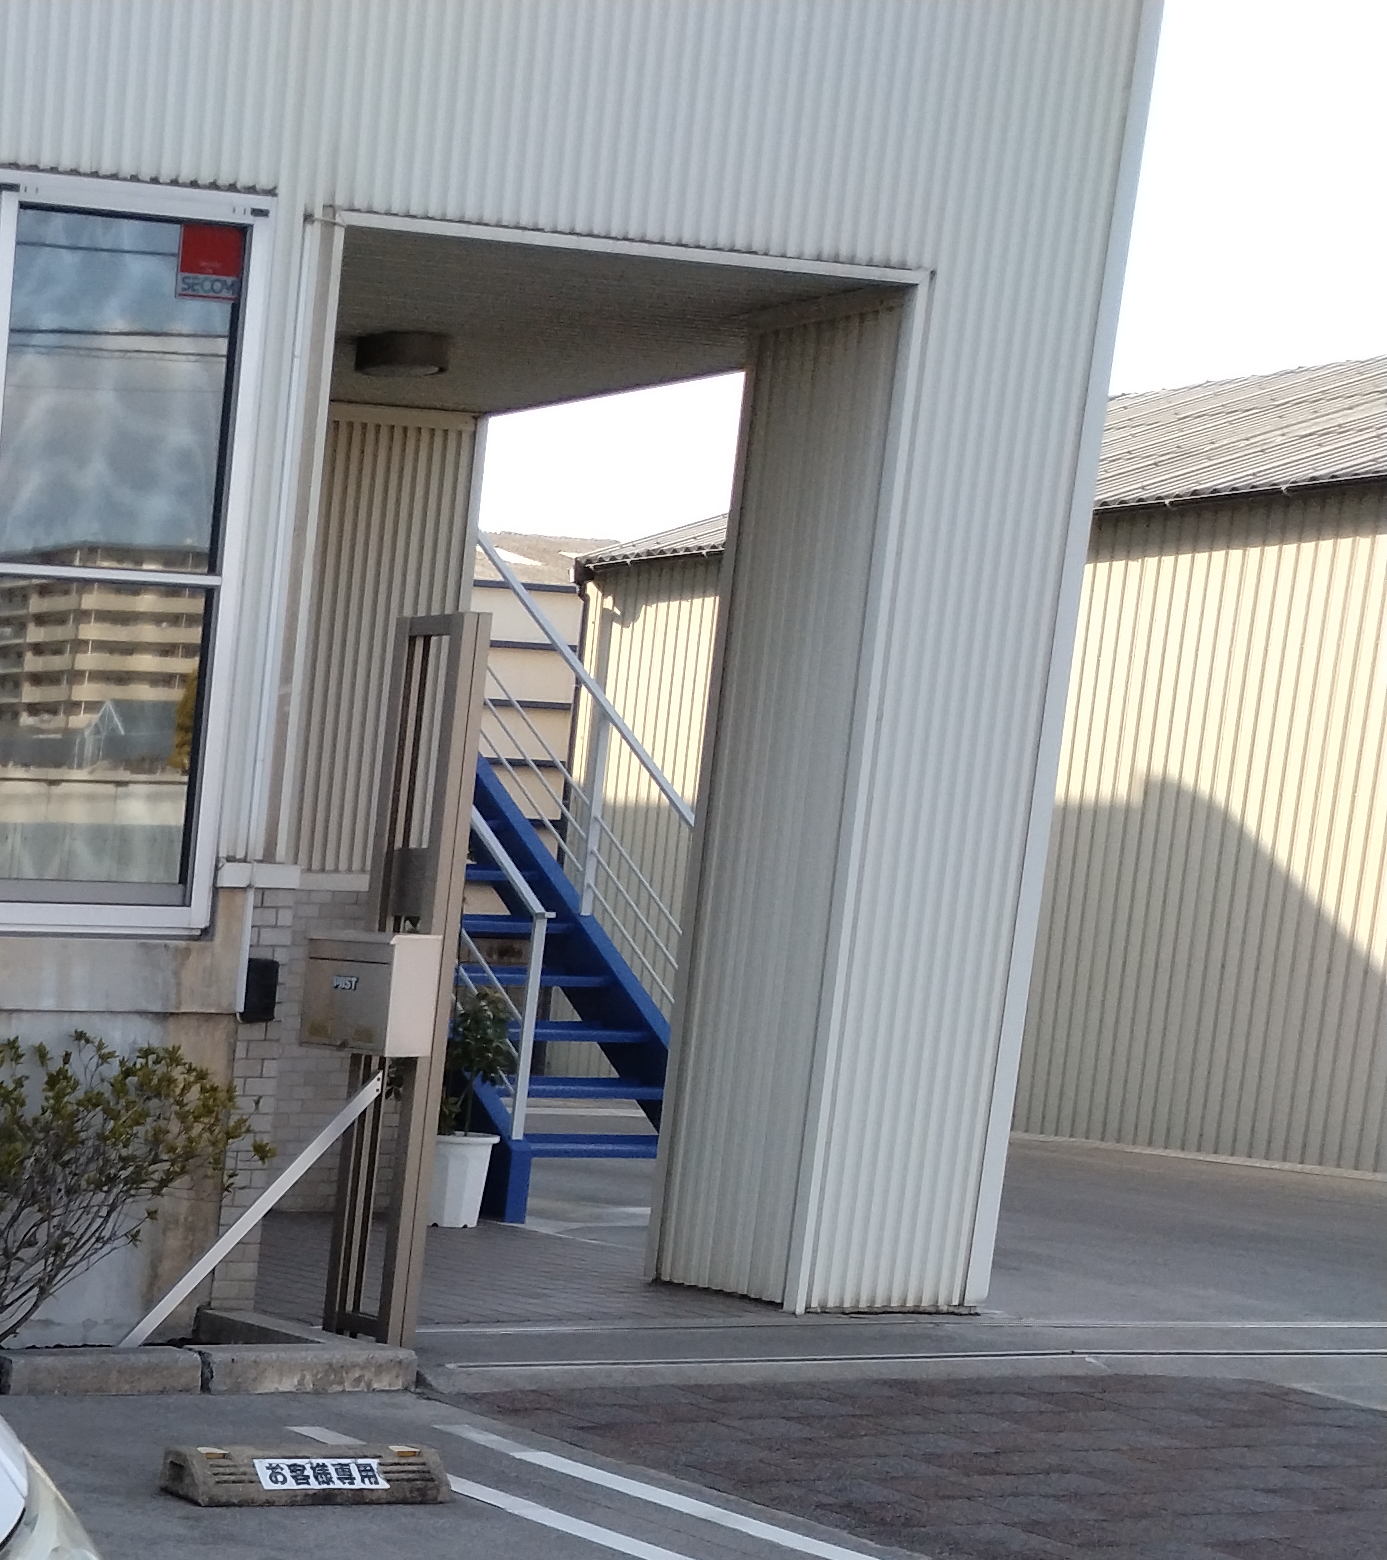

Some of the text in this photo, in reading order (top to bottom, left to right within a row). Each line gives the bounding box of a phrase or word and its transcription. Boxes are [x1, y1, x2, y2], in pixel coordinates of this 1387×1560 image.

[265, 1461, 380, 1487] お客様専用
